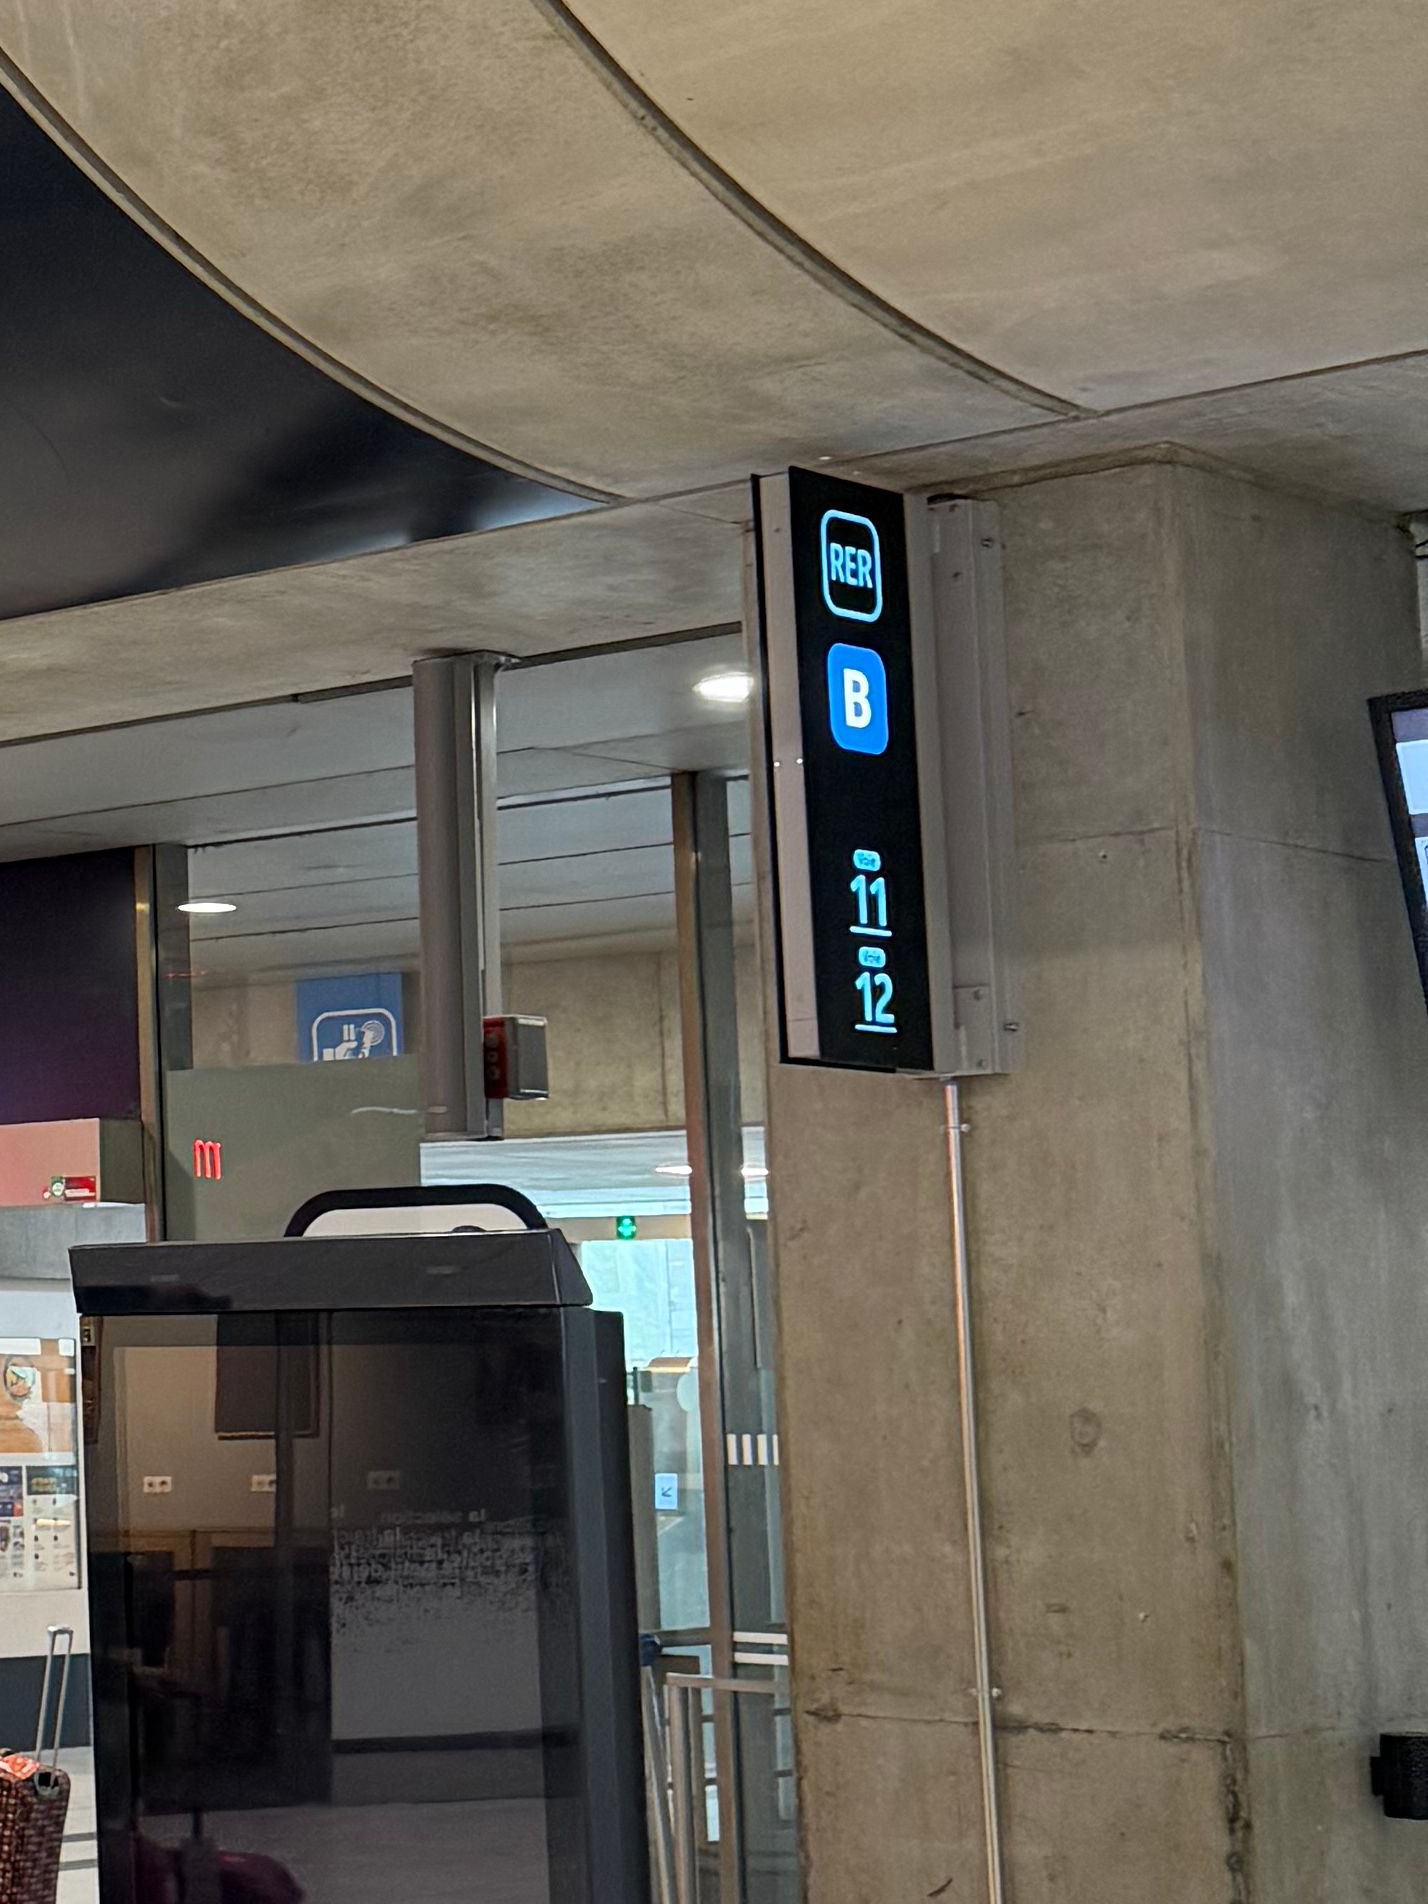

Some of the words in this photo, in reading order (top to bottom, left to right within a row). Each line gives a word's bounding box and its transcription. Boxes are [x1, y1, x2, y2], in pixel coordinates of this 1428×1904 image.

[829, 542, 874, 589] RER
[843, 668, 872, 729] B
[850, 874, 888, 927] 11
[855, 971, 896, 1024] 12
